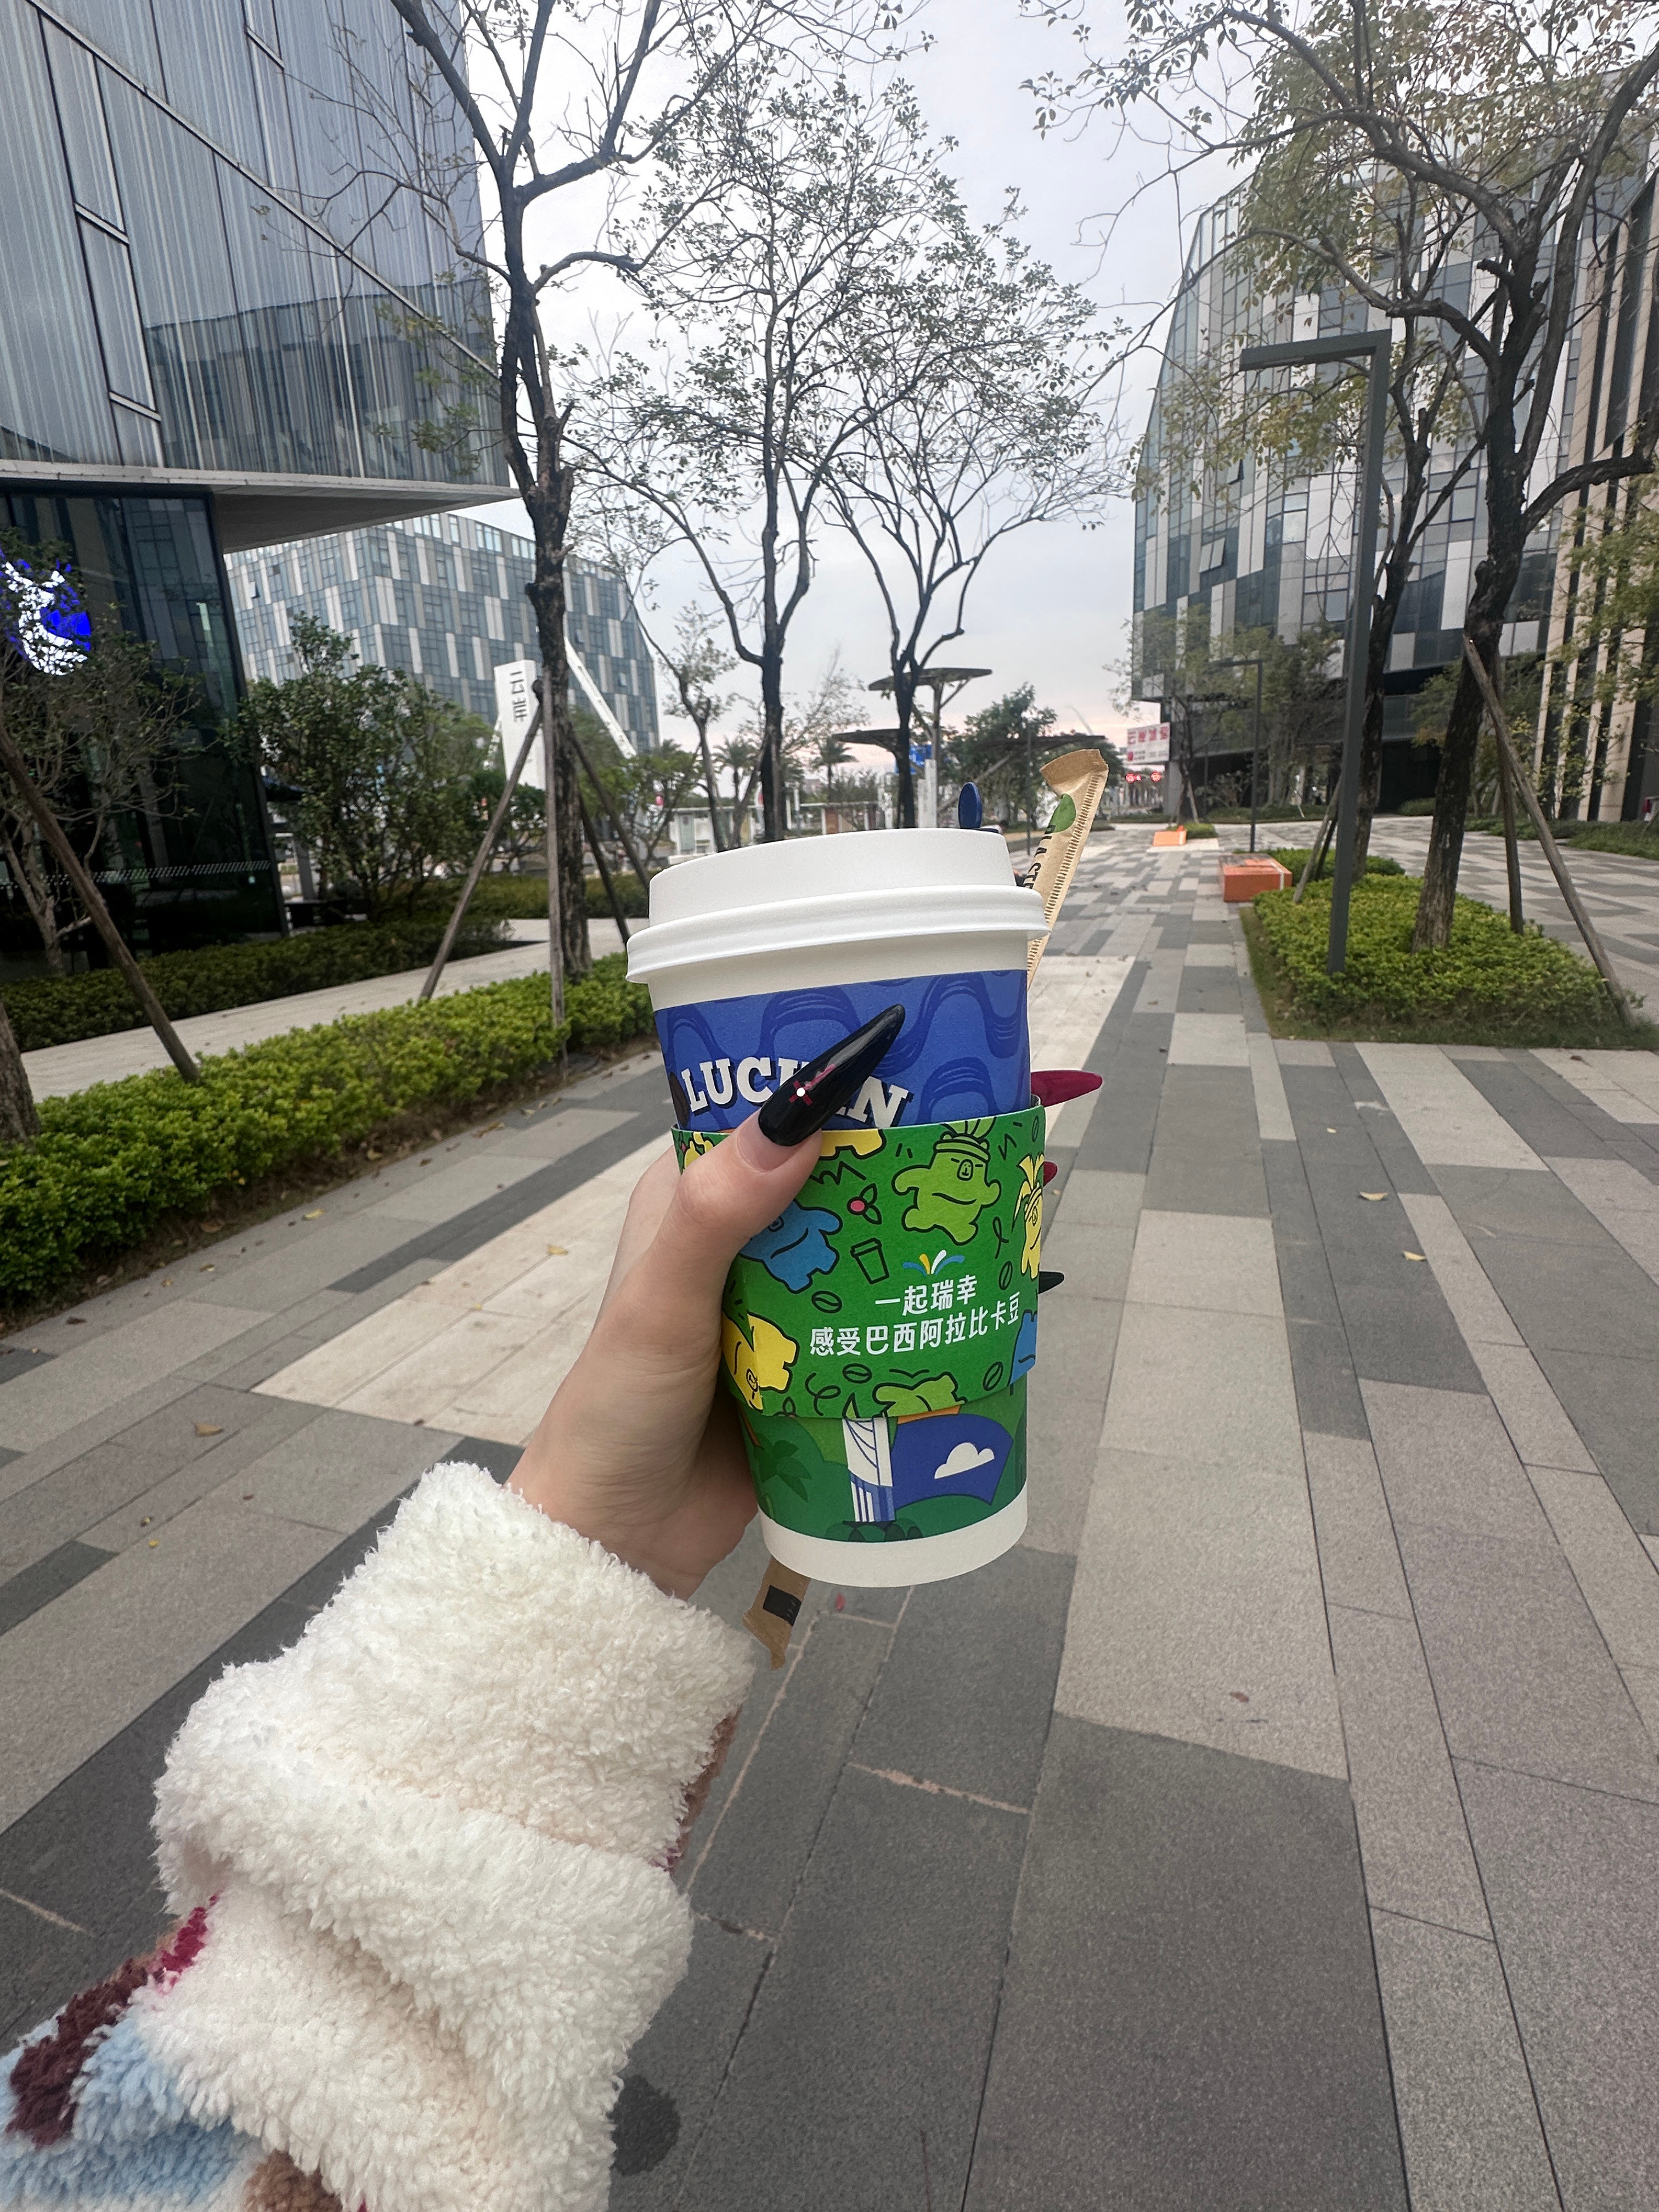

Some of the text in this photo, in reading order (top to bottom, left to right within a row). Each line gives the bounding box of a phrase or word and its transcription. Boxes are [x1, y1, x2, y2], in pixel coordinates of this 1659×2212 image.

[681, 1056, 910, 1127] LUCN
[810, 1291, 1020, 1356] 感受巴西阿拉比卡豆
[875, 1274, 977, 1316] 一起瑞幸
